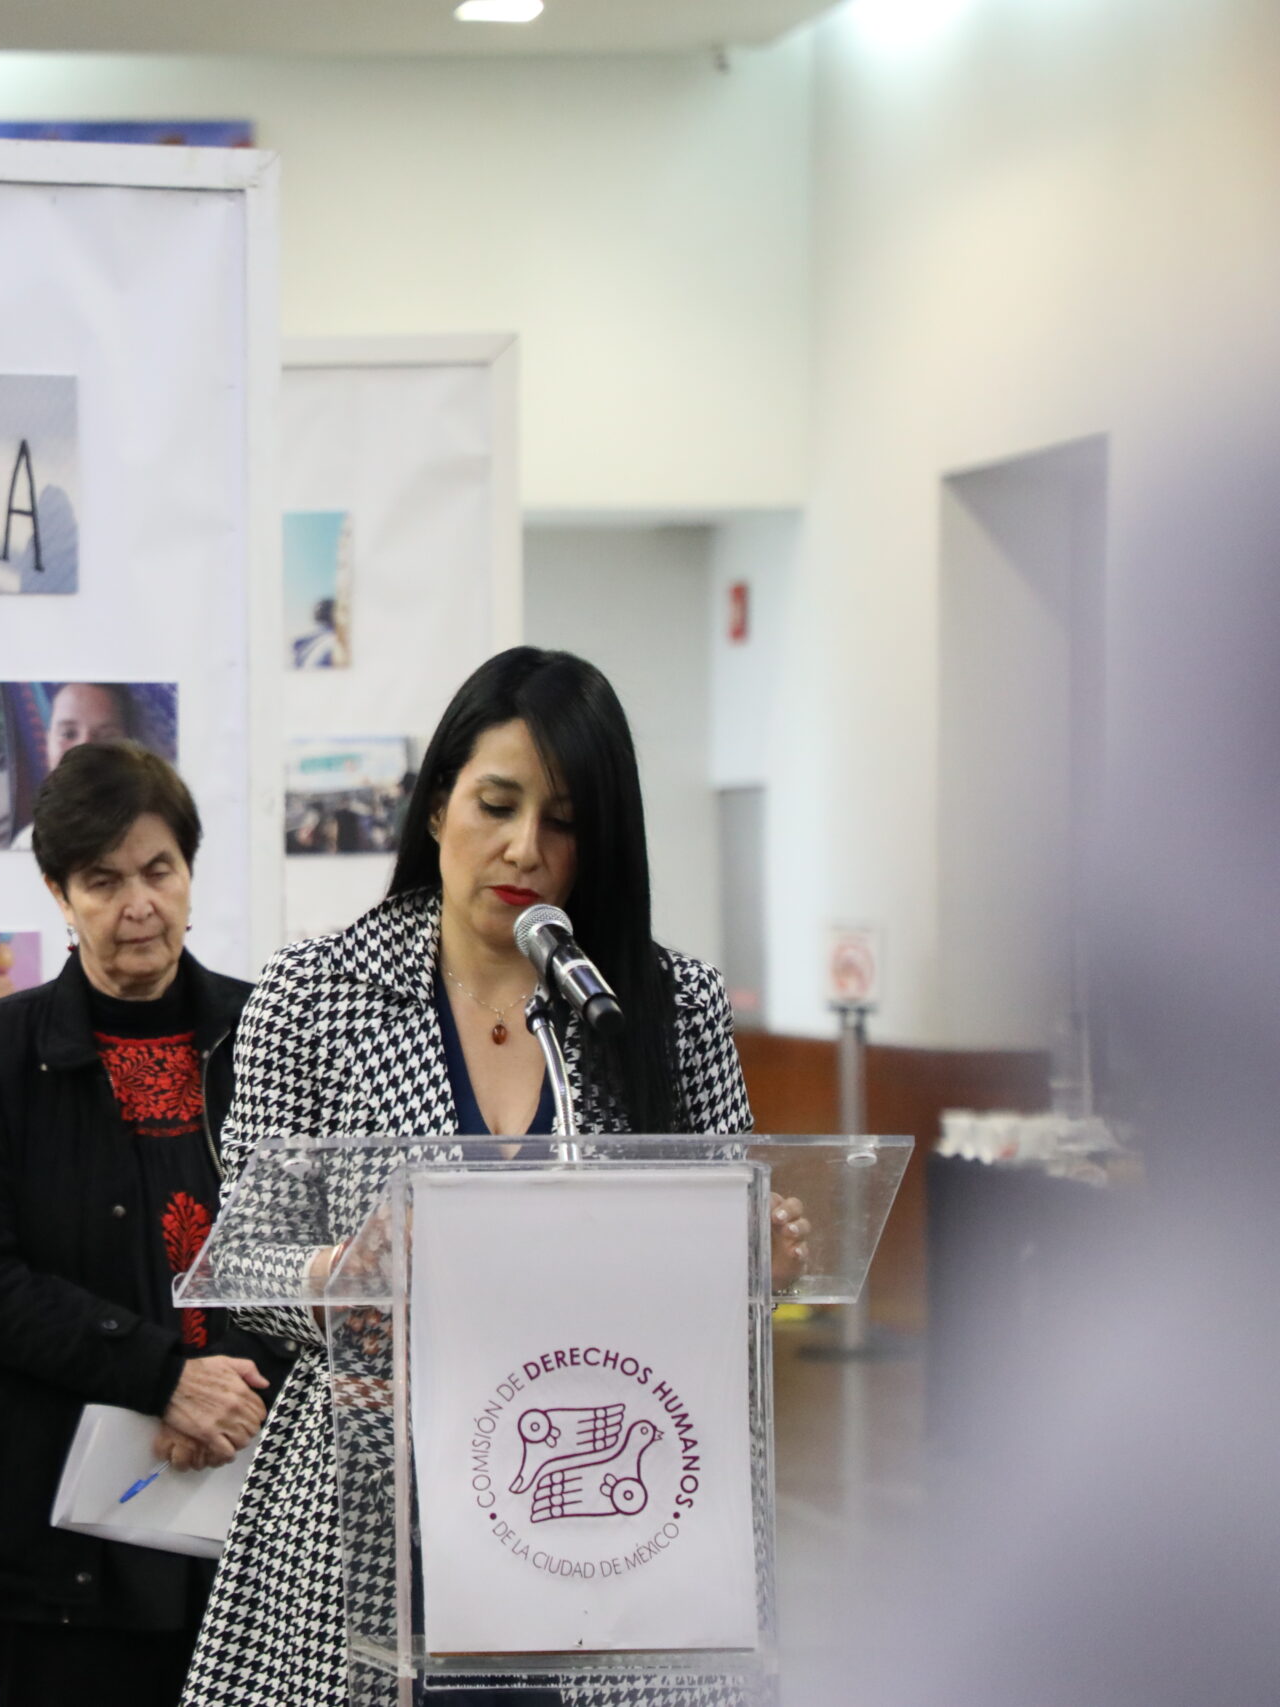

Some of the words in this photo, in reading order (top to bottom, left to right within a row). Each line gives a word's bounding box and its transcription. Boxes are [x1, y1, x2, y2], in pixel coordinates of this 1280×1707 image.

[472, 1400, 503, 1509] COMISIÓN
[496, 1373, 525, 1402] DE
[523, 1347, 653, 1385] DERECHOS
[652, 1380, 700, 1509] HUMANOS
[492, 1520, 515, 1546] DE
[511, 1539, 530, 1561] LA
[532, 1551, 596, 1579] CIUDAD
[600, 1558, 622, 1578] DE
[624, 1522, 680, 1571] MÉXICO
